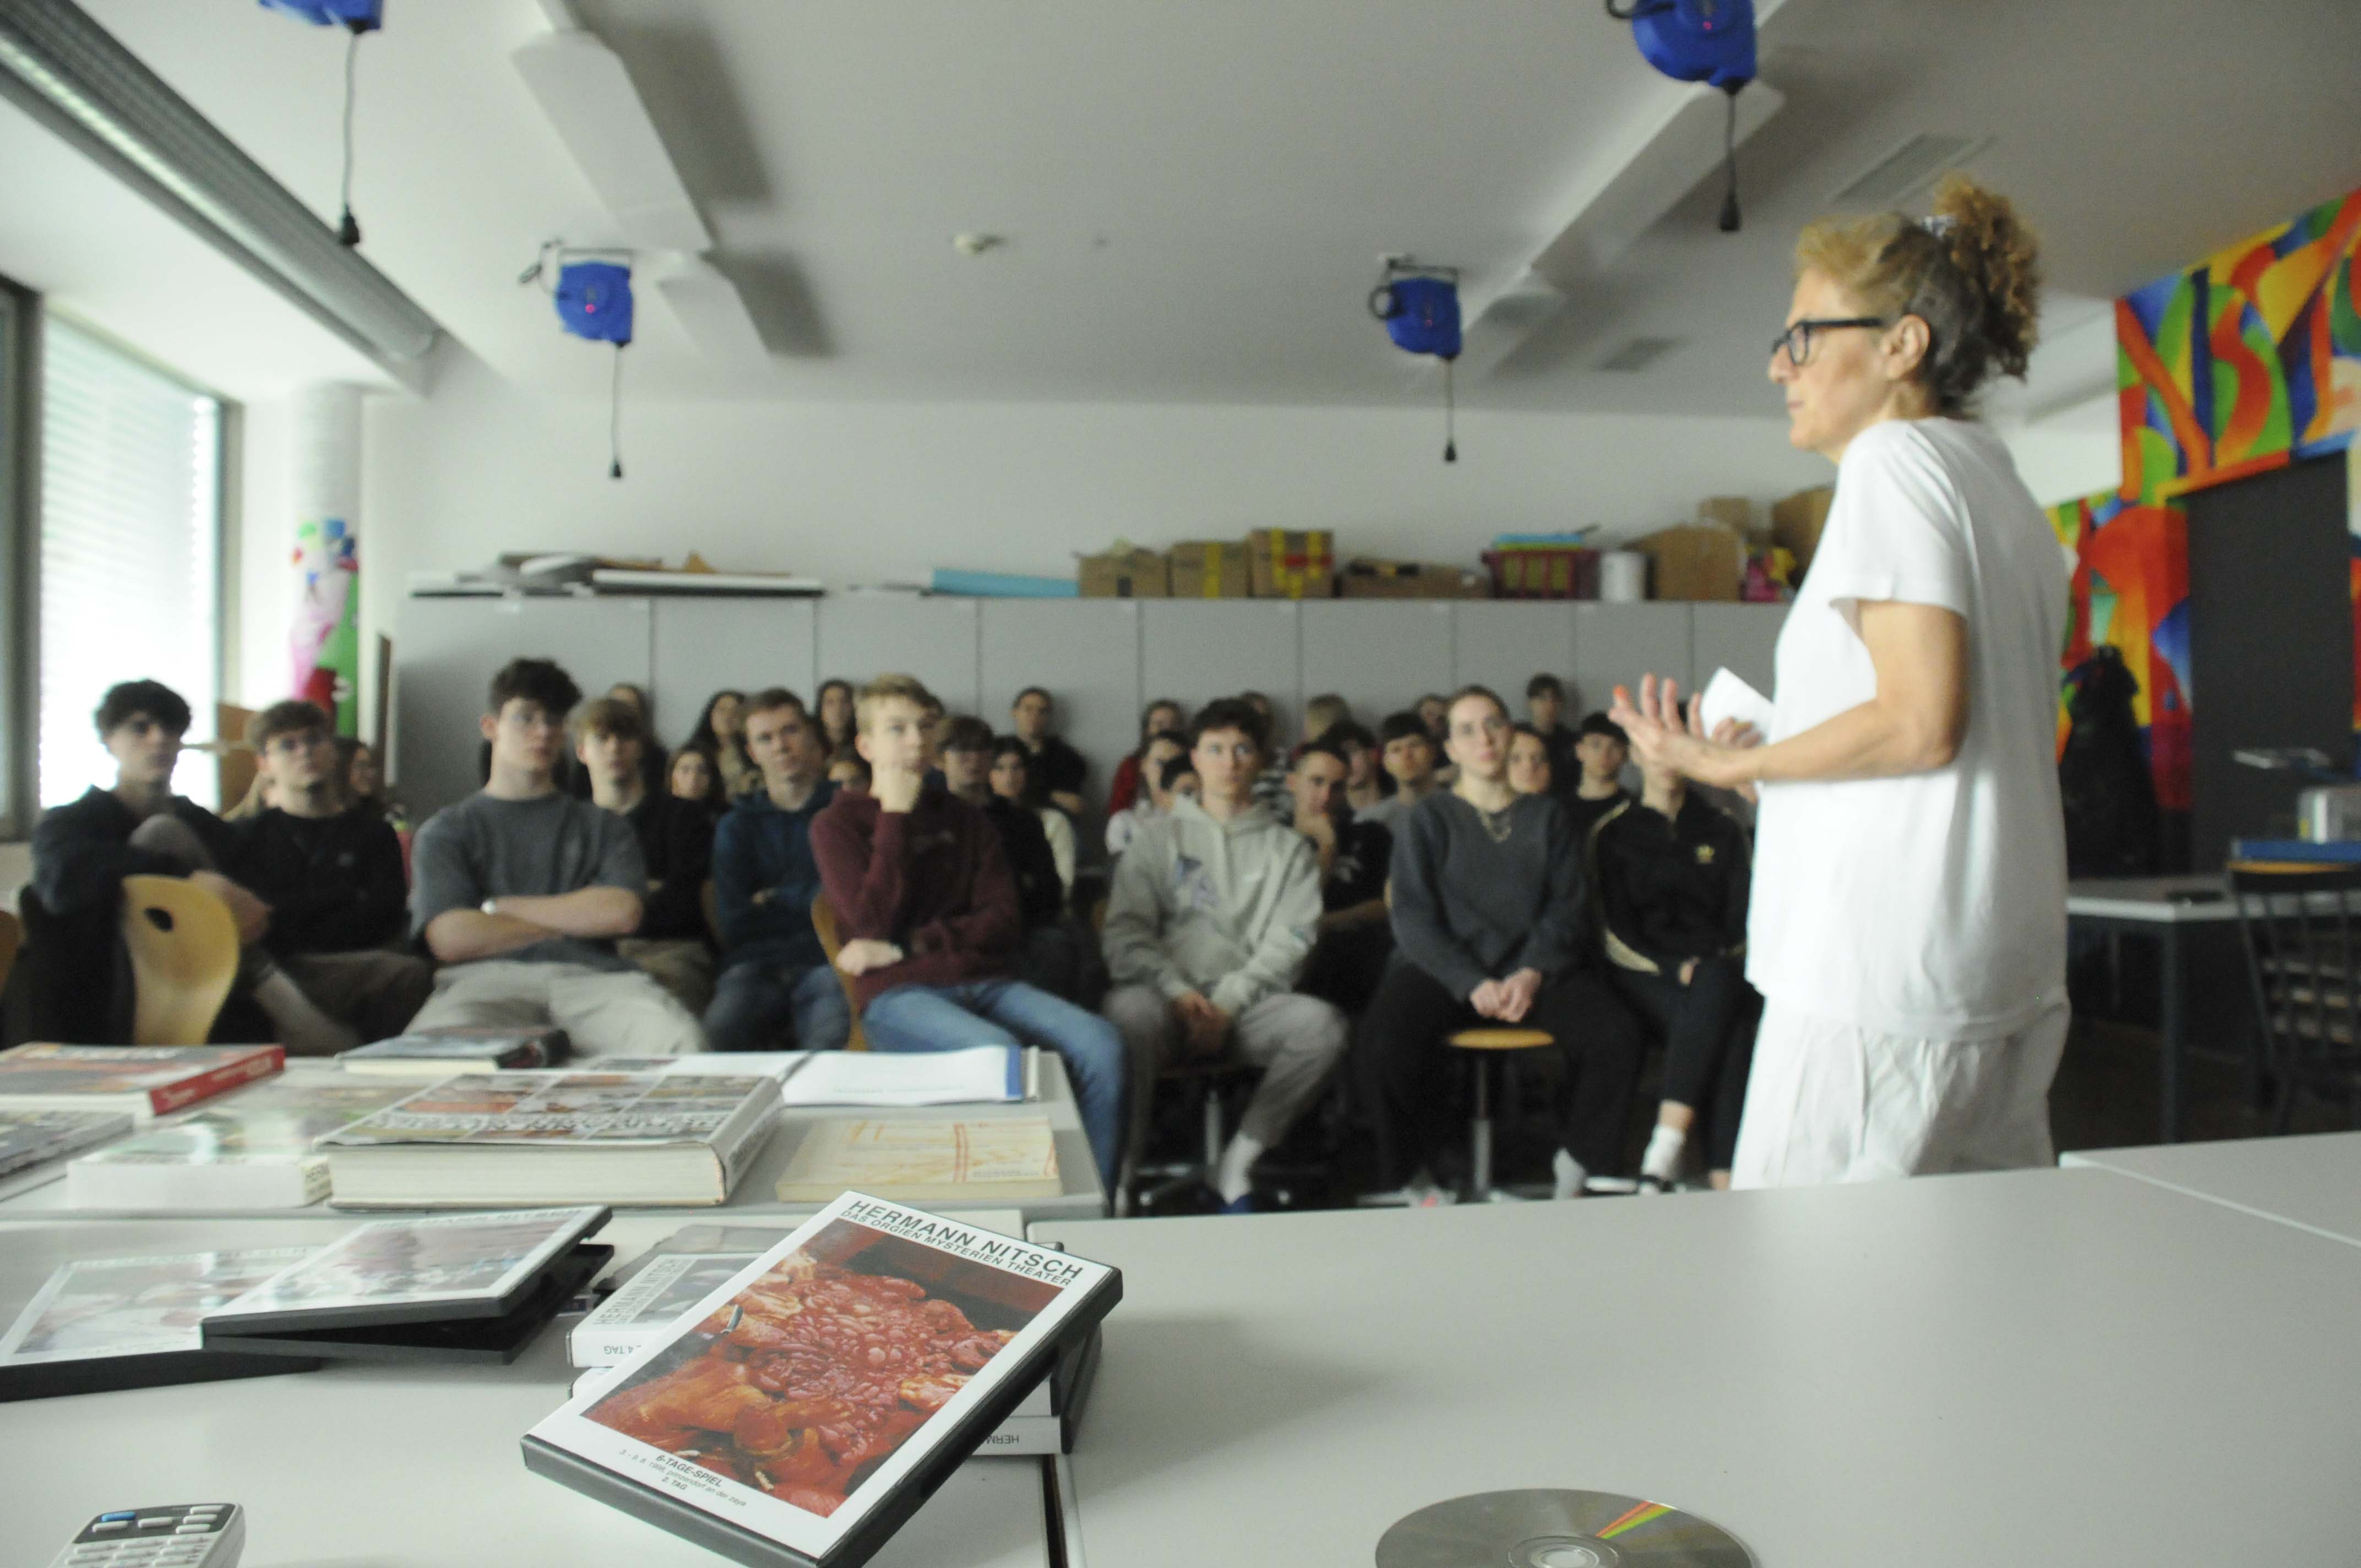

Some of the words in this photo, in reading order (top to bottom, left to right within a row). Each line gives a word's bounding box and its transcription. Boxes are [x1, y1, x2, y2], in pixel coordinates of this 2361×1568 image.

[841, 1210, 865, 1223] DAS
[871, 1219, 922, 1239] ORGIEN
[924, 1236, 1003, 1265] MYSTERIEN
[1008, 1261, 1071, 1287] THEATER
[849, 1201, 977, 1246] HERMANN
[981, 1240, 1084, 1279] NITSCH
[656, 1455, 723, 1487] 6-TAGE-SPIEL
[671, 1479, 688, 1490] TAG
